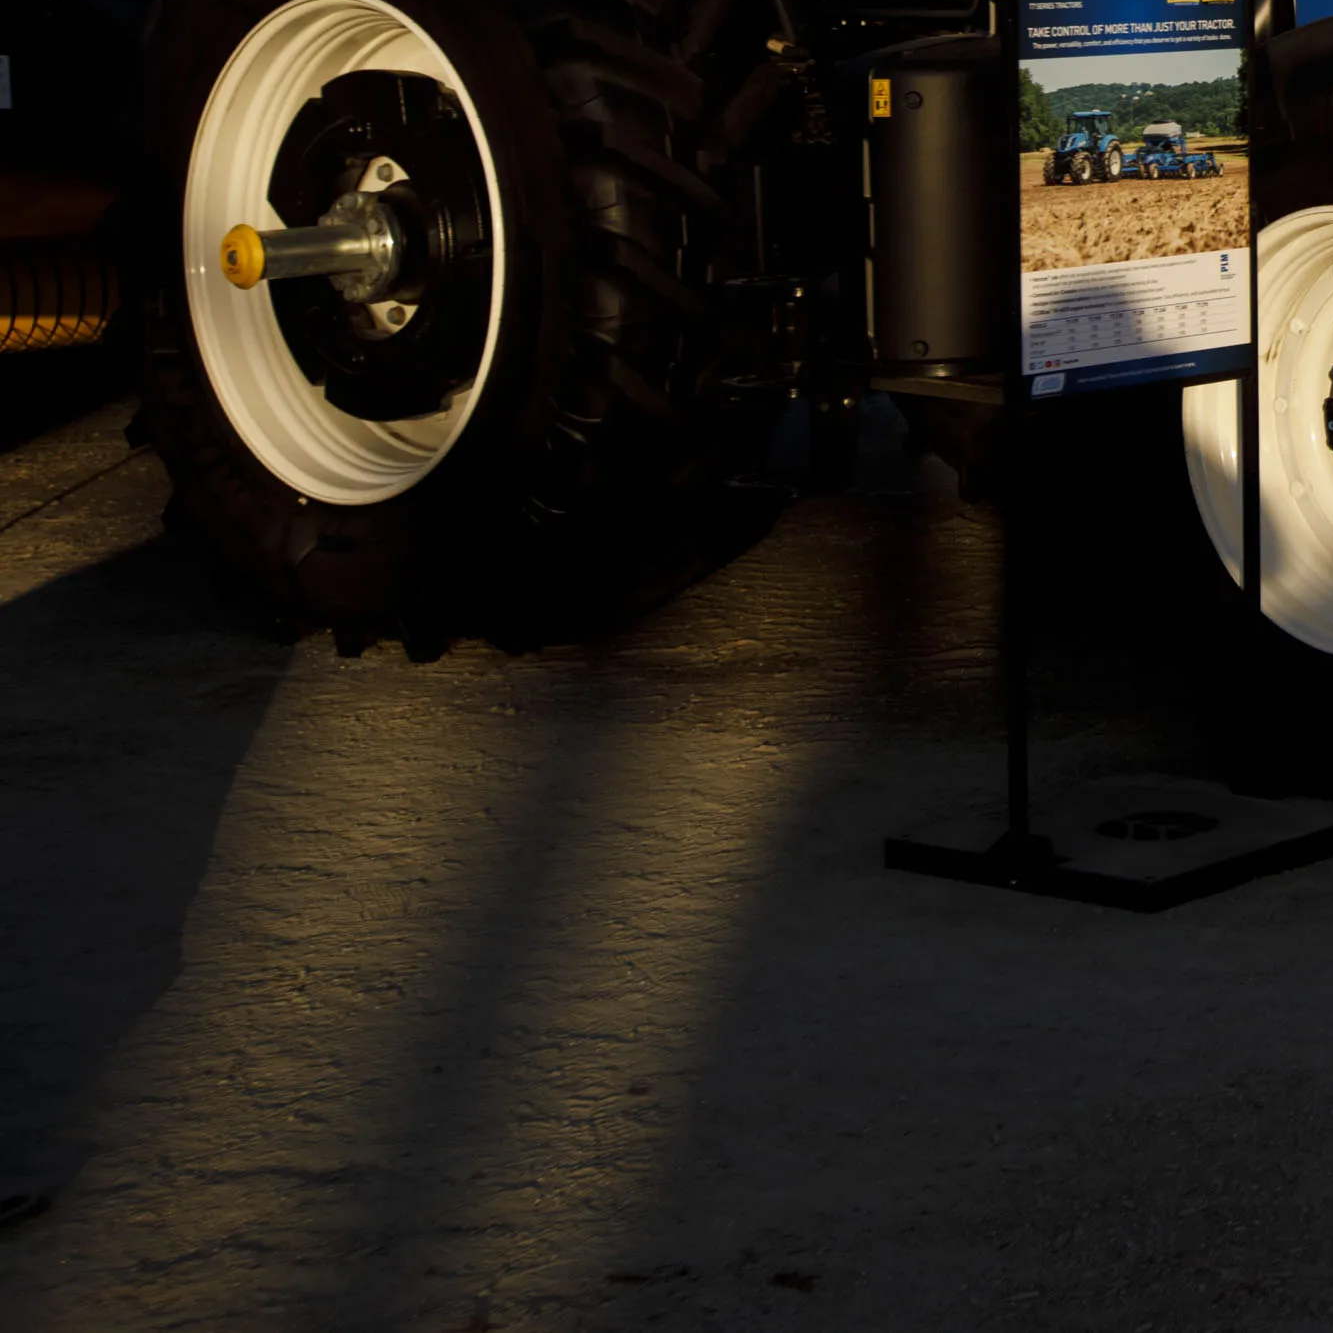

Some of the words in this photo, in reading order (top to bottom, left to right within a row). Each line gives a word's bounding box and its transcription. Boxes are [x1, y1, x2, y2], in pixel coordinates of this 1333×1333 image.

[1026, 26, 1051, 39] TAKE
[1051, 24, 1092, 37] CONTROL
[1091, 23, 1104, 35] OF
[1104, 22, 1129, 35] MORE
[1129, 21, 1153, 33] THAN
[1153, 20, 1174, 32] JUST
[1174, 19, 1198, 32] YOUR
[1197, 18, 1236, 31] TRACTOR.
[1220, 253, 1229, 273] PLM
